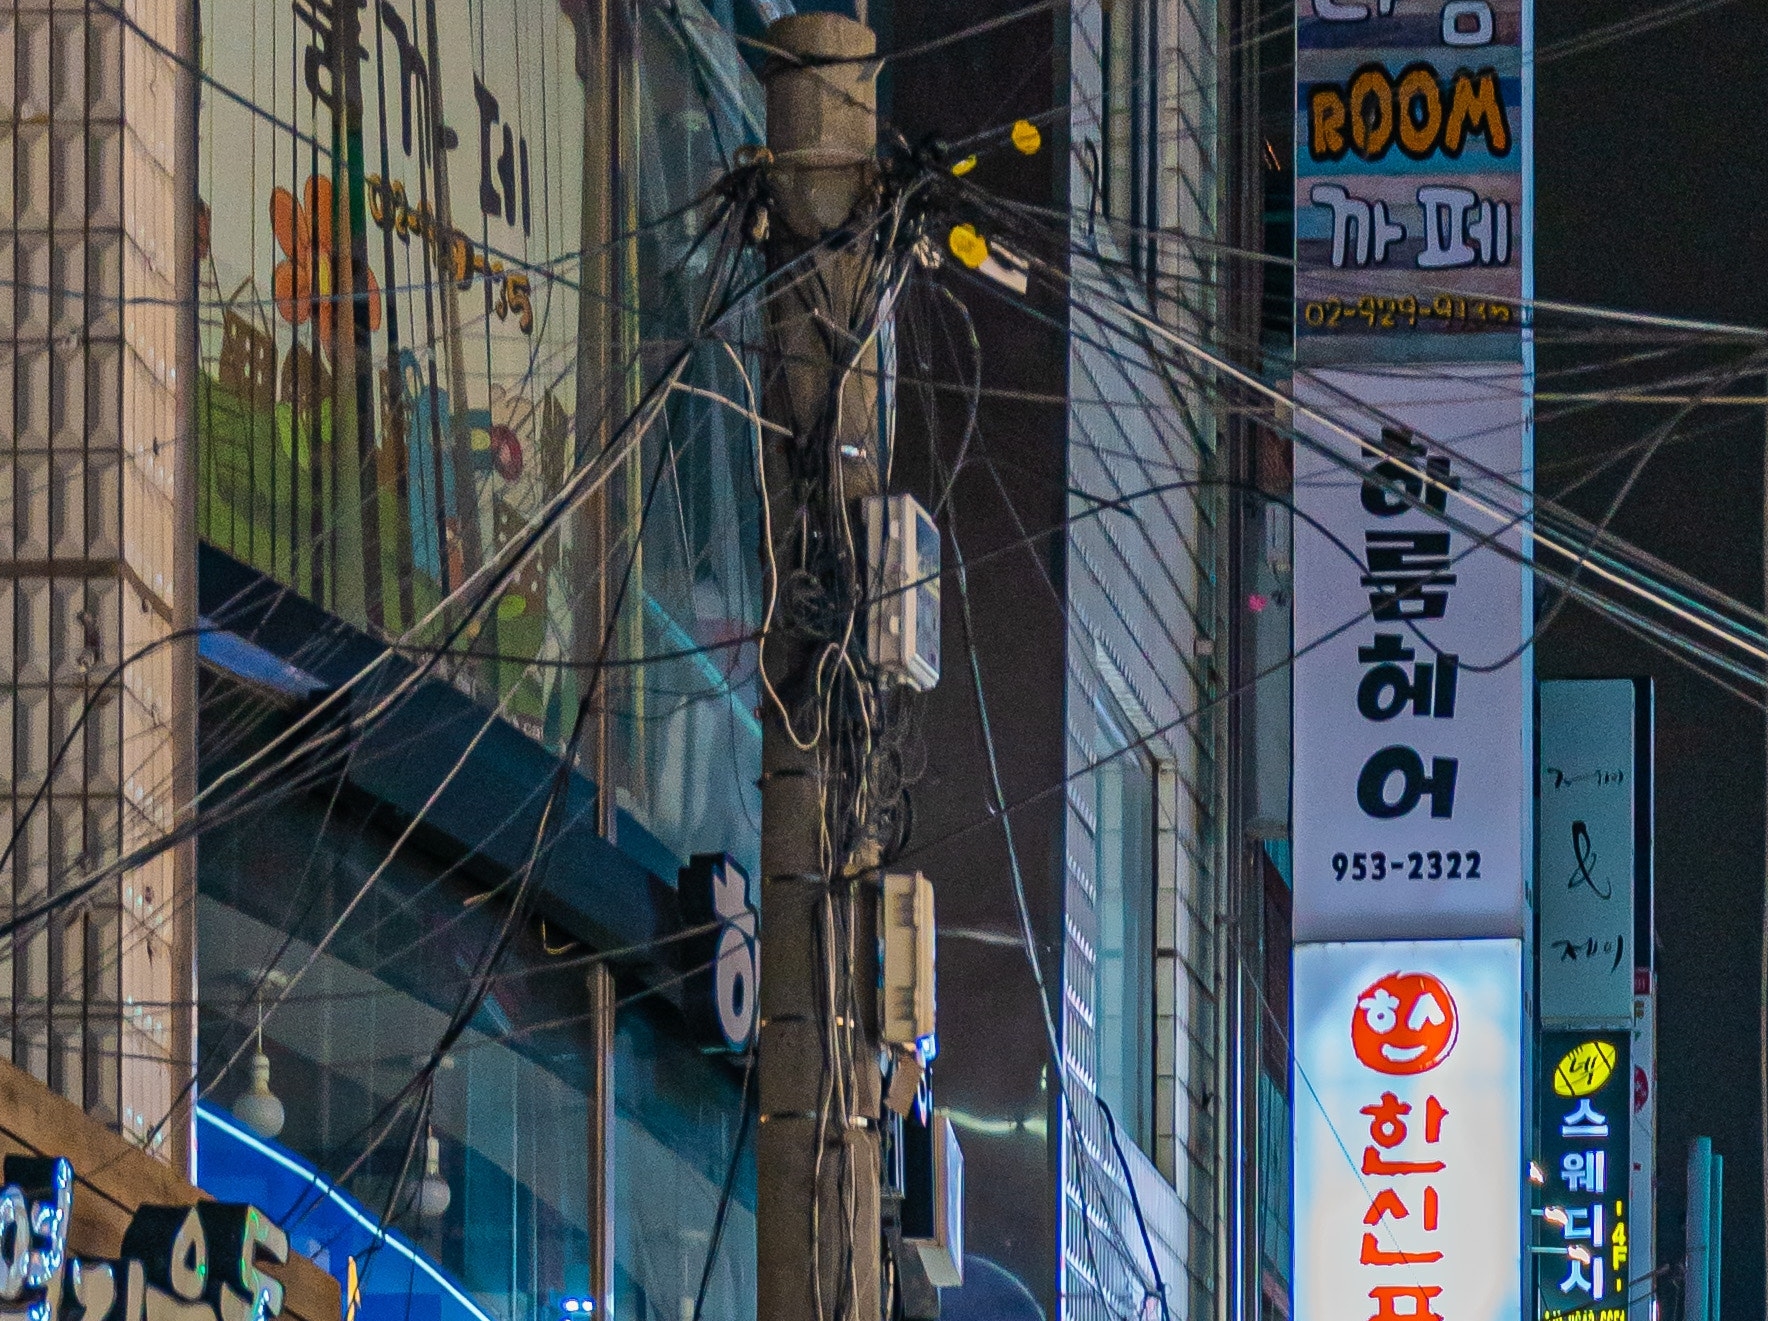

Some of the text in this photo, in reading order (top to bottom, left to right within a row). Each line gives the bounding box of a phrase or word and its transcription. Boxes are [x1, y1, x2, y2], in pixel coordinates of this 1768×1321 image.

[1310, 65, 1510, 158] ROOM
[1332, 851, 1481, 881] 953-2322
[1560, 1098, 1609, 1299] 스웨디시
